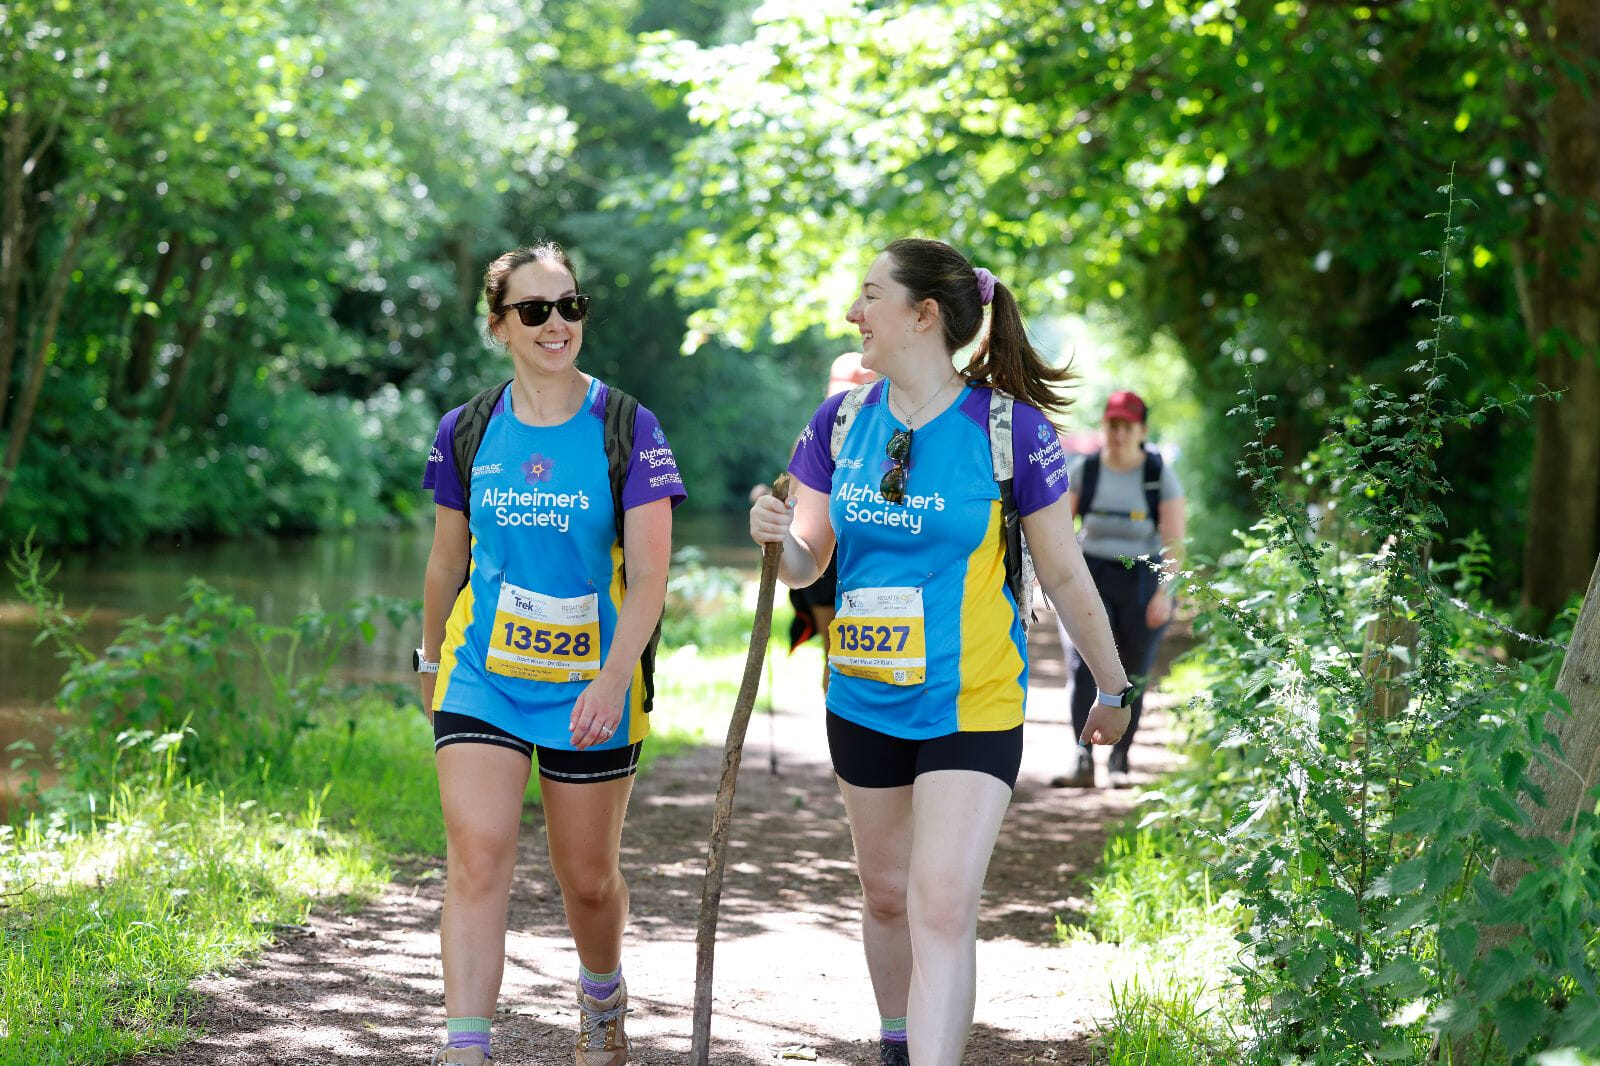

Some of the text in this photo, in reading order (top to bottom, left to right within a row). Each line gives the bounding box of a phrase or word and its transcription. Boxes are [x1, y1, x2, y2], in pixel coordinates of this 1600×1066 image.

[481, 487, 590, 510] Alzheimer's
[495, 506, 570, 533] Society
[844, 501, 923, 535] Society
[504, 621, 591, 657] 13528
[837, 624, 911, 652] 13527
